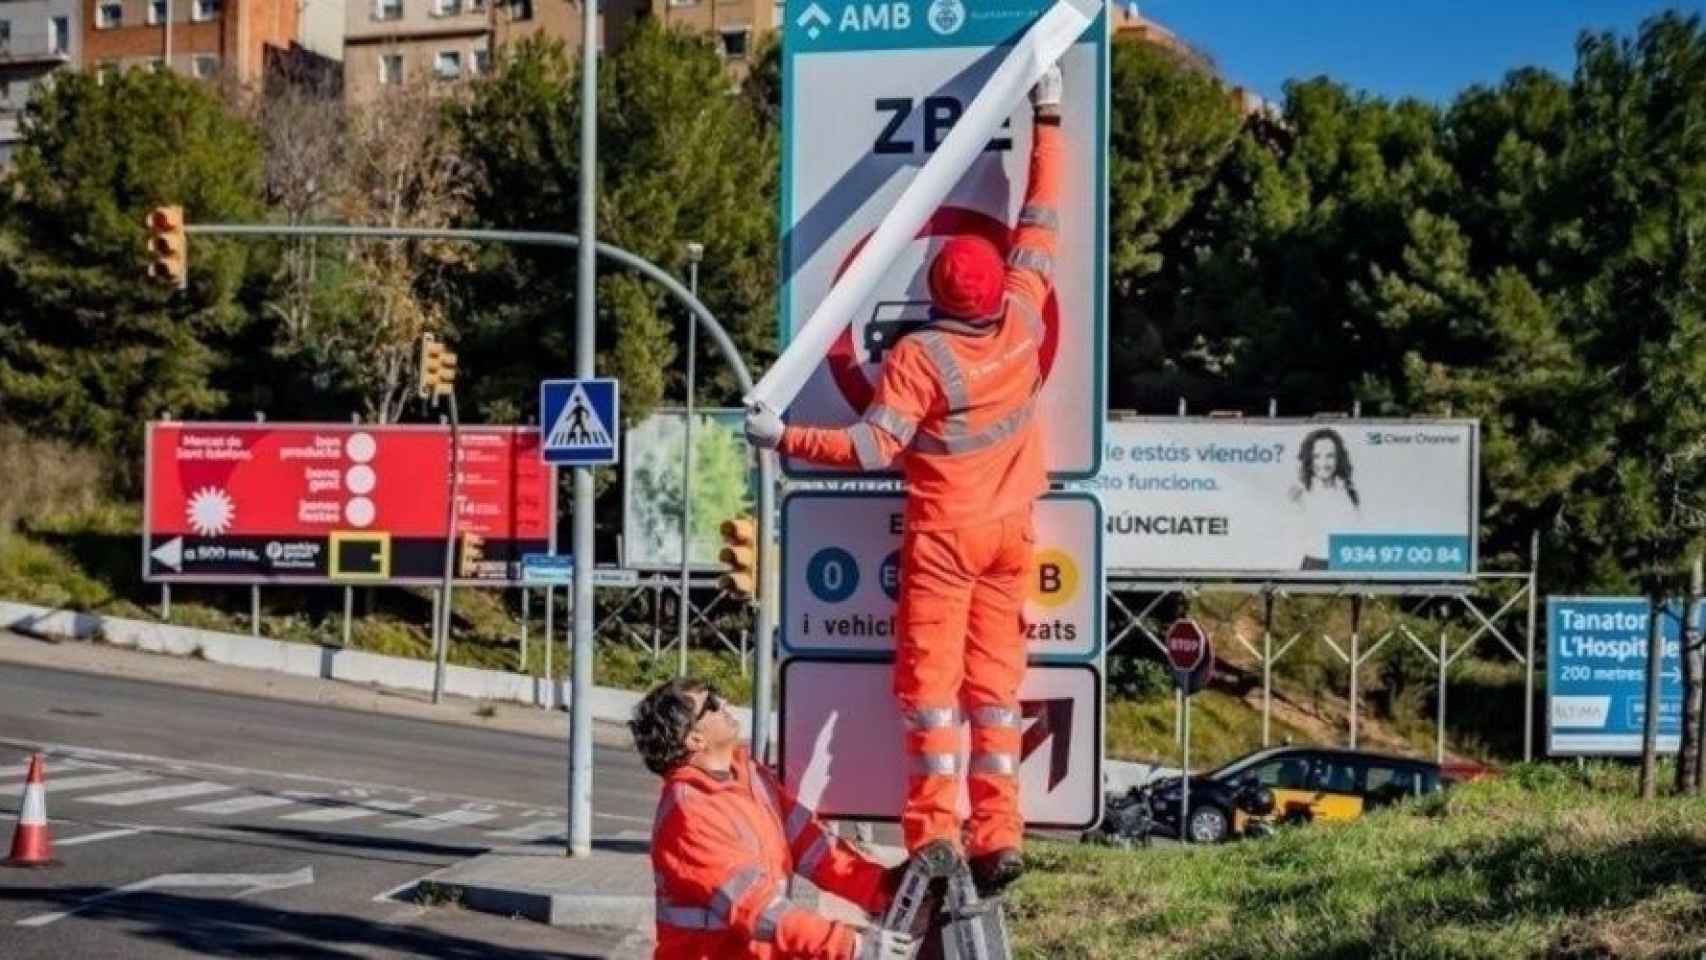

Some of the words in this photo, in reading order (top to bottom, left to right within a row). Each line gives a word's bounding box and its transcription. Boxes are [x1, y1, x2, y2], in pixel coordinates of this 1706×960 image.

[839, 3, 911, 32] AMB
[1197, 443, 1285, 463] viendo?
[1098, 474, 1122, 490] sto
[1128, 473, 1220, 491] funciona.
[1340, 546, 1376, 563] 934
[1380, 545, 1403, 563] 97
[1407, 546, 1432, 563] 00
[1437, 546, 1462, 563] 84
[1040, 563, 1061, 593] B
[803, 612, 809, 635] i
[825, 612, 897, 637] vehicl
[1559, 609, 1649, 631] Tanator
[1171, 638, 1198, 652] STOP
[1561, 666, 1591, 681] 200
